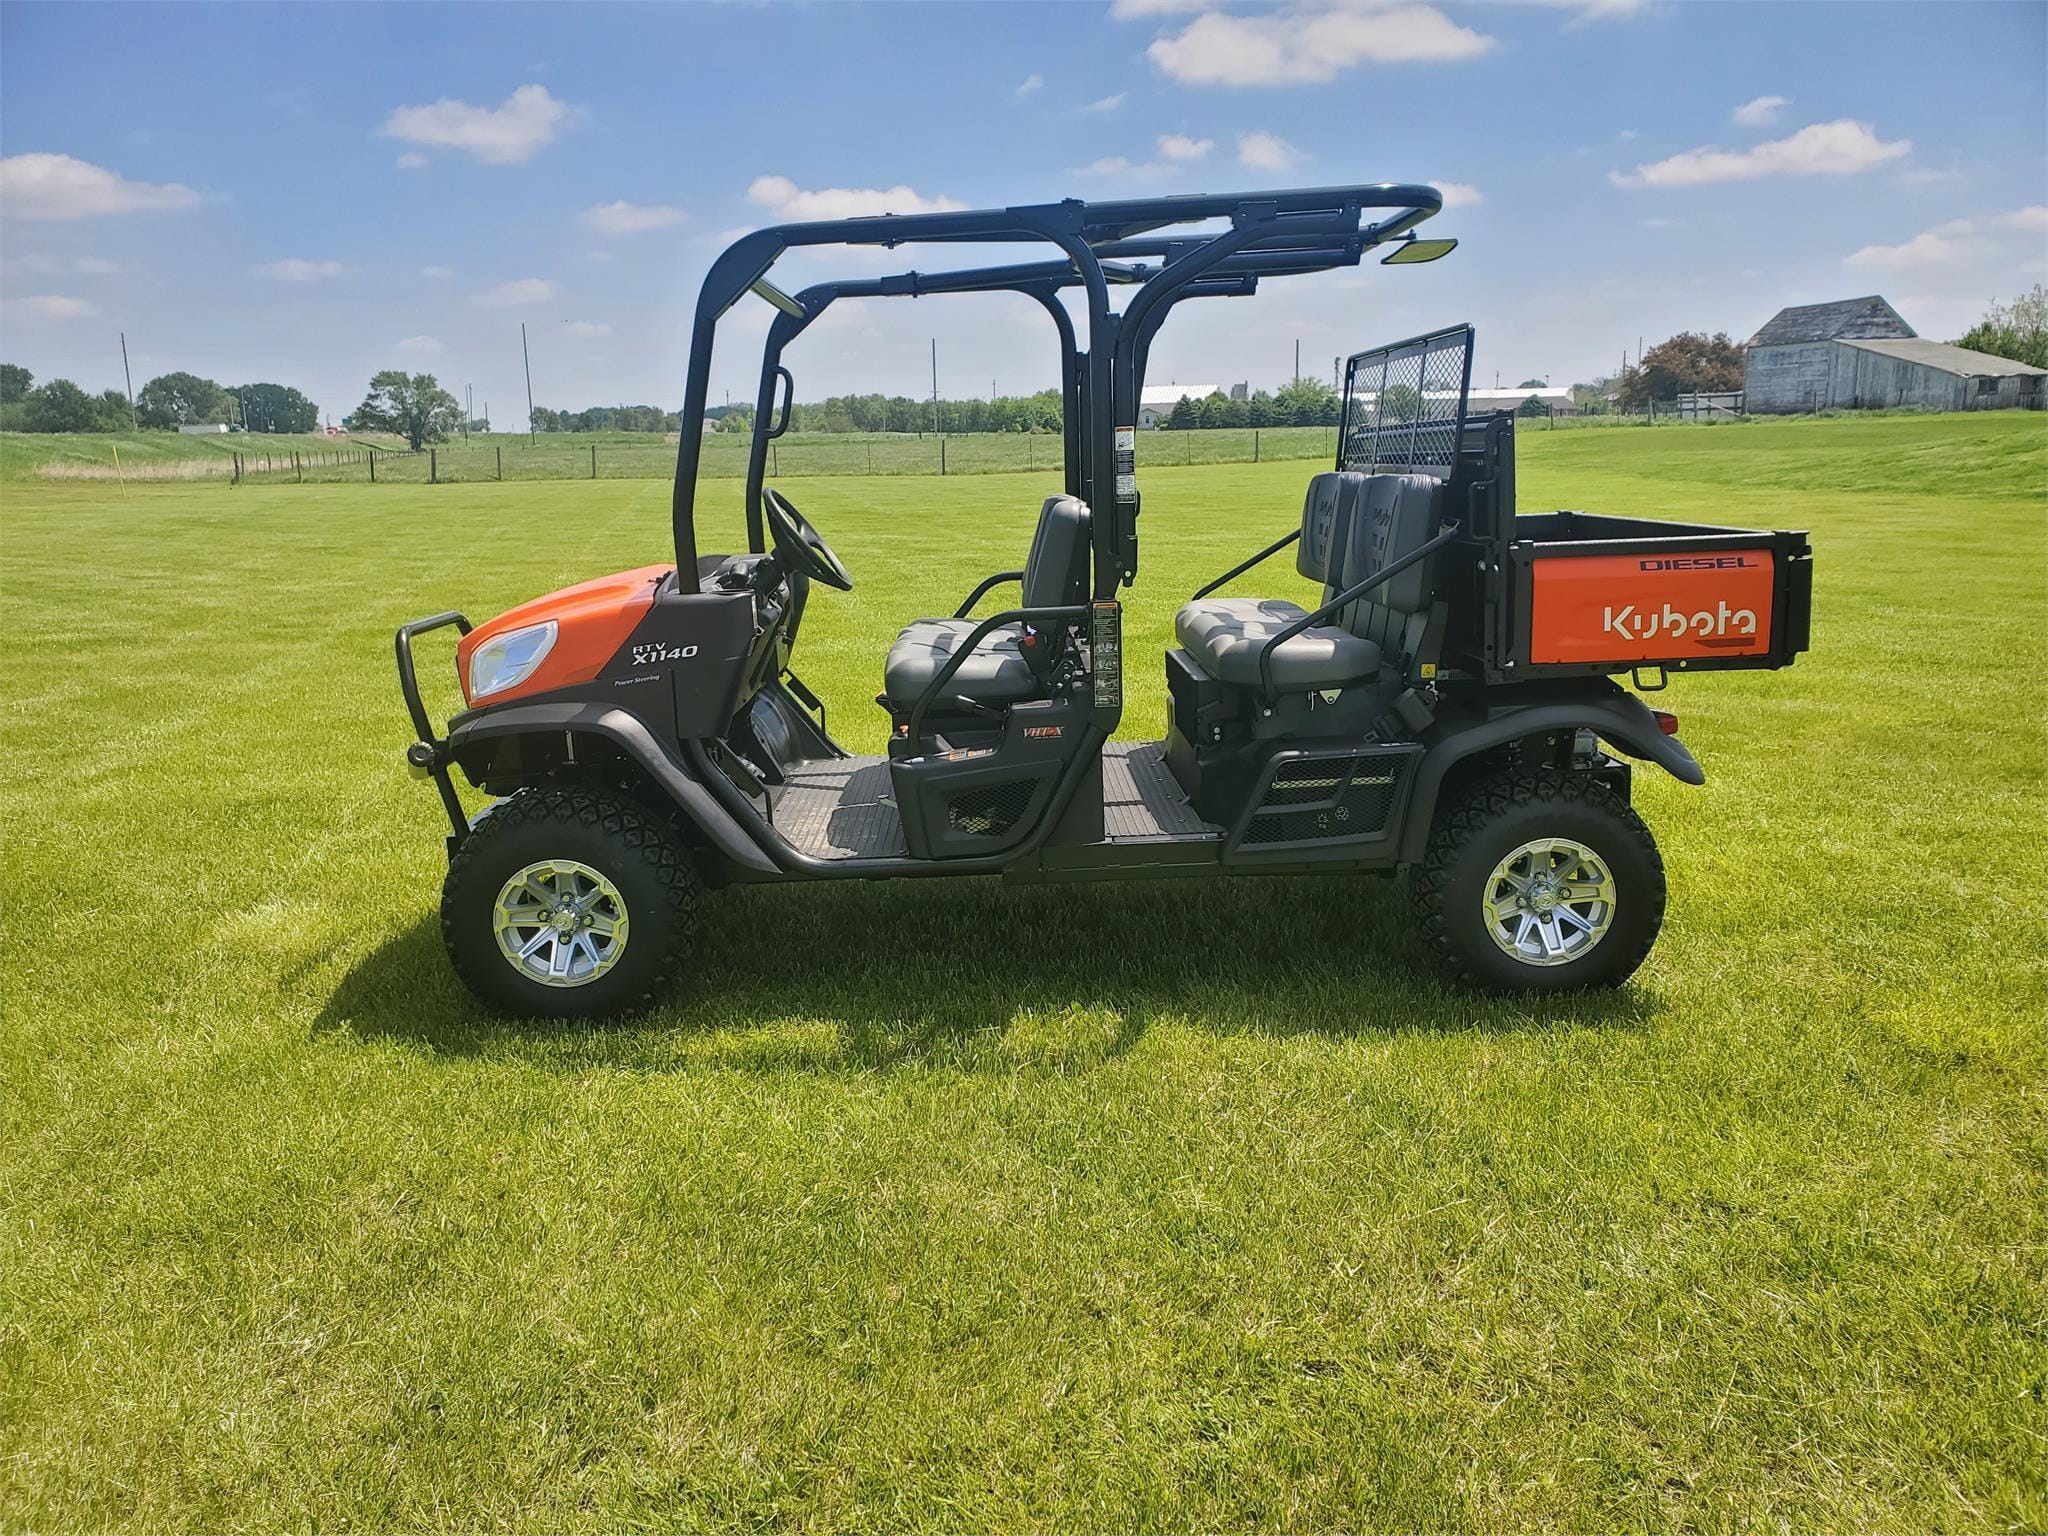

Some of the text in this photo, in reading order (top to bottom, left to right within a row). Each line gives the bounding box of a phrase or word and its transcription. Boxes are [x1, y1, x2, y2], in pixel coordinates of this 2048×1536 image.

[1640, 557, 1759, 571] DIESEL
[1603, 600, 1757, 640] Kubota
[632, 642, 666, 654] RTV
[632, 645, 698, 666] X1140
[614, 675, 660, 687] Power Steering
